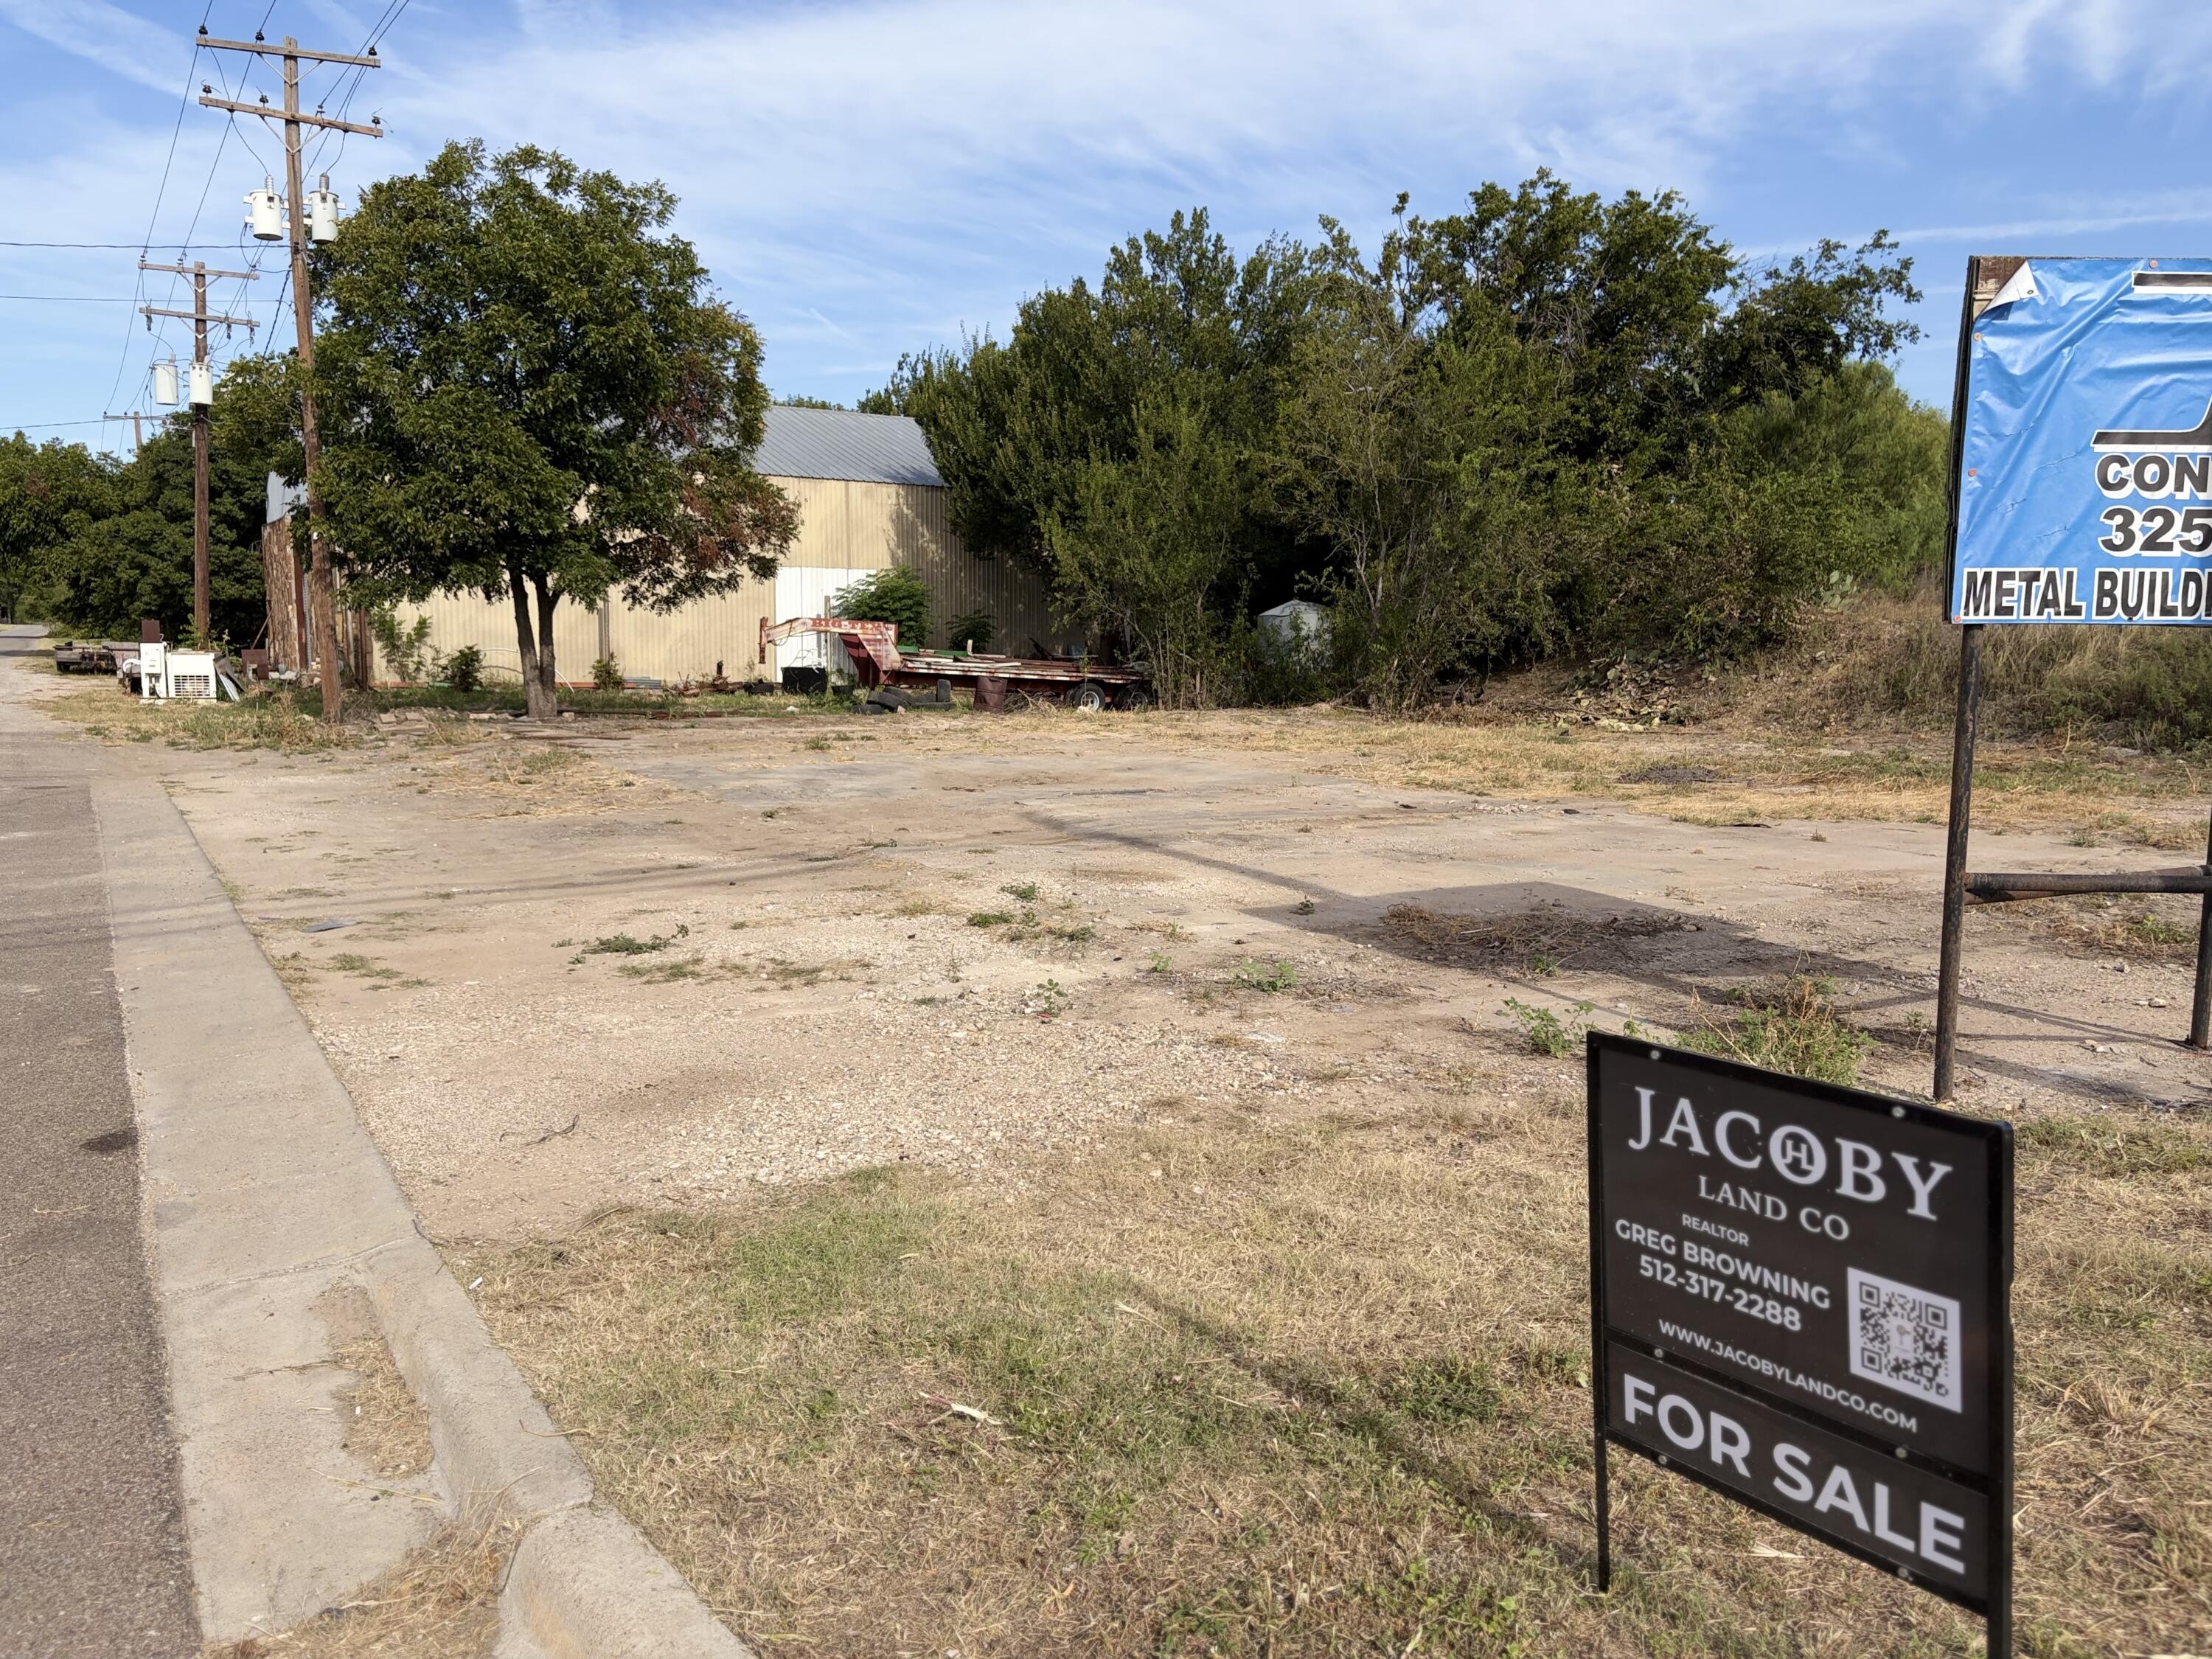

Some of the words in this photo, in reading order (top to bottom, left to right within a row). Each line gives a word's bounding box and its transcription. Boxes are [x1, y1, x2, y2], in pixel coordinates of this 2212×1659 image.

[2096, 454, 2209, 497] CON
[1962, 568, 2085, 620] METAL
[1628, 1086, 1952, 1221] JACOBY
[1682, 1214, 1749, 1247] REALTOR
[1698, 1175, 1787, 1221] LAND
[1799, 1207, 1849, 1240] CO
[1615, 1219, 1676, 1256] GREG
[1683, 1240, 1830, 1309] BROWNING
[1639, 1254, 1801, 1332] 512-317-2288
[1658, 1319, 1917, 1433] WWW.JACOBYLANDCO.COM
[1624, 1373, 1751, 1478] FOR
[1773, 1442, 1965, 1574] SALE
